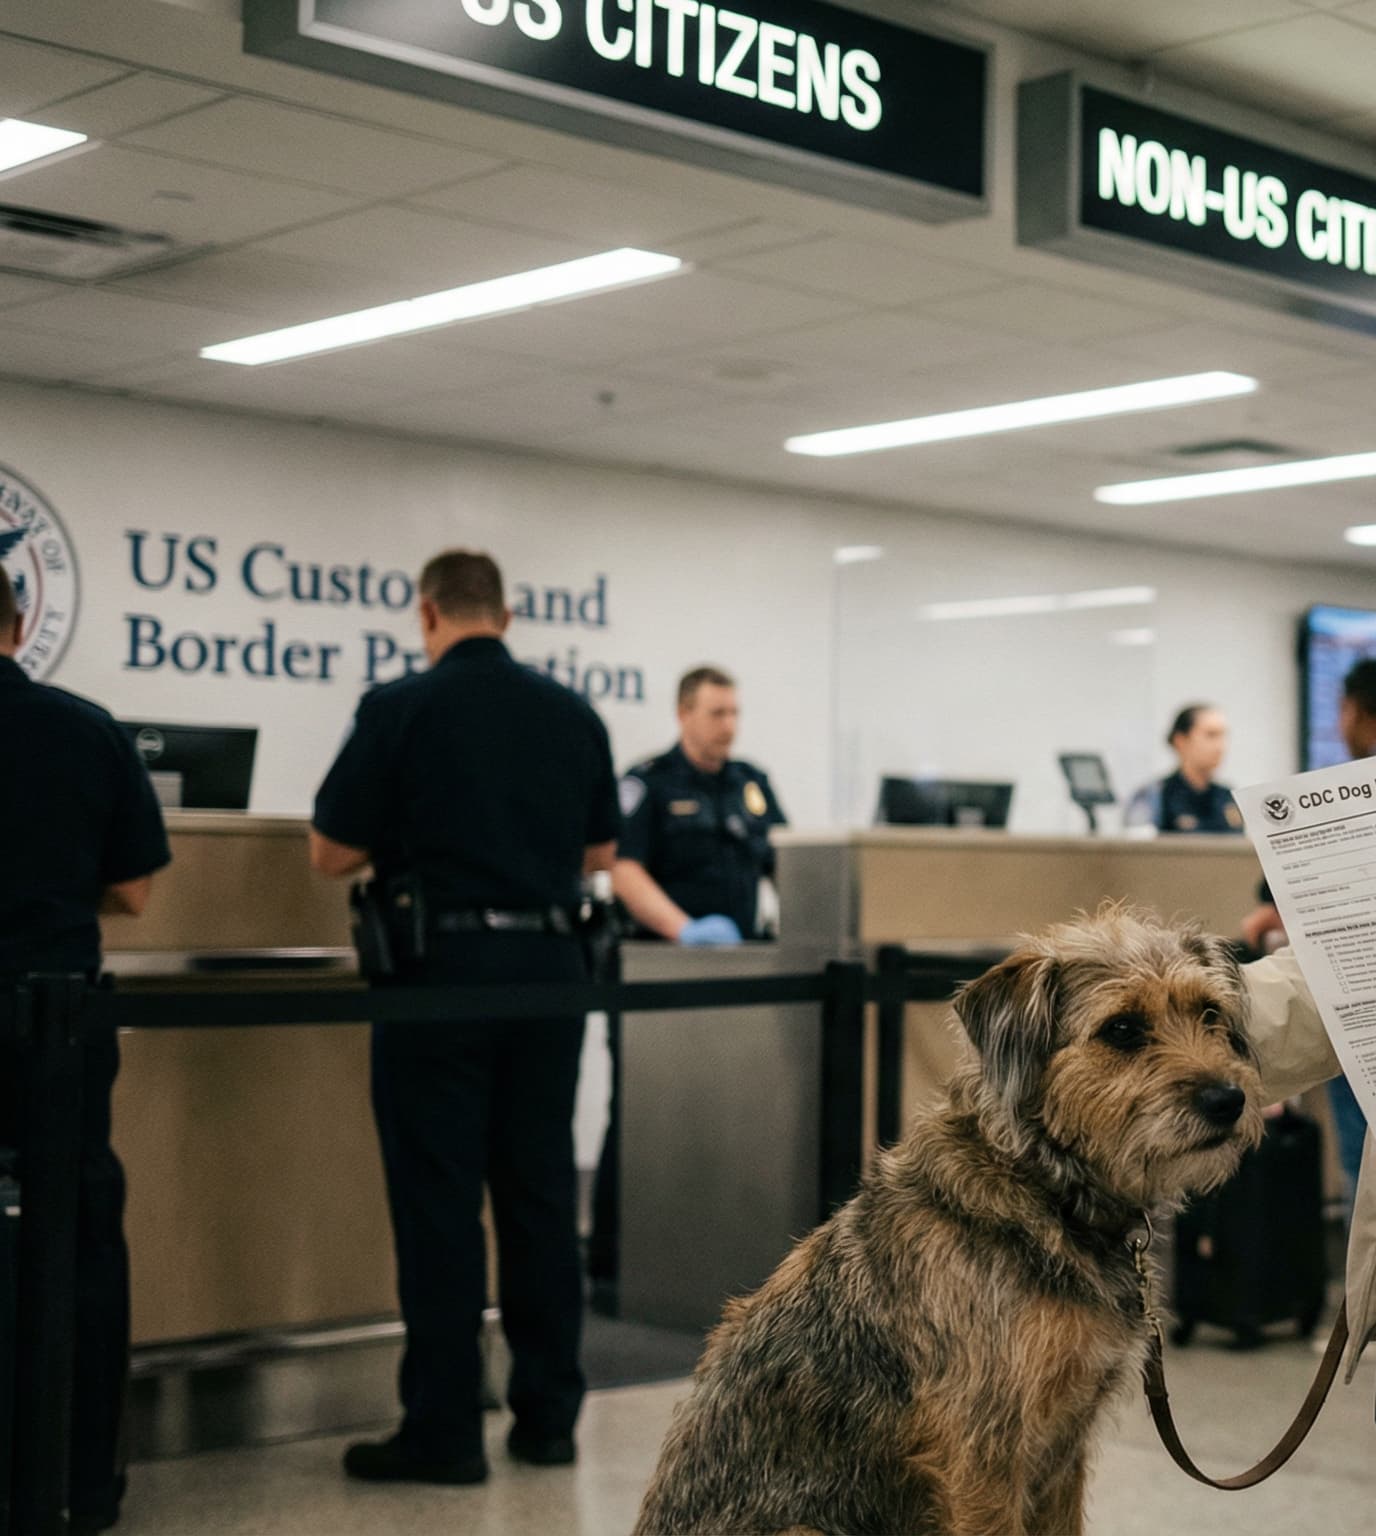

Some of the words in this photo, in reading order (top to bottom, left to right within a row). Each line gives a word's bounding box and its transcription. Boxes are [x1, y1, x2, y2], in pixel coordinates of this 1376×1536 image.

[585, 0, 882, 131] CITIZENS
[1099, 127, 1289, 249] NON-US
[125, 529, 219, 594] US
[241, 542, 417, 610] Custo
[513, 573, 609, 628] and
[124, 612, 341, 682] Border
[1298, 789, 1334, 809] CDC
[1338, 783, 1372, 798] Dog
